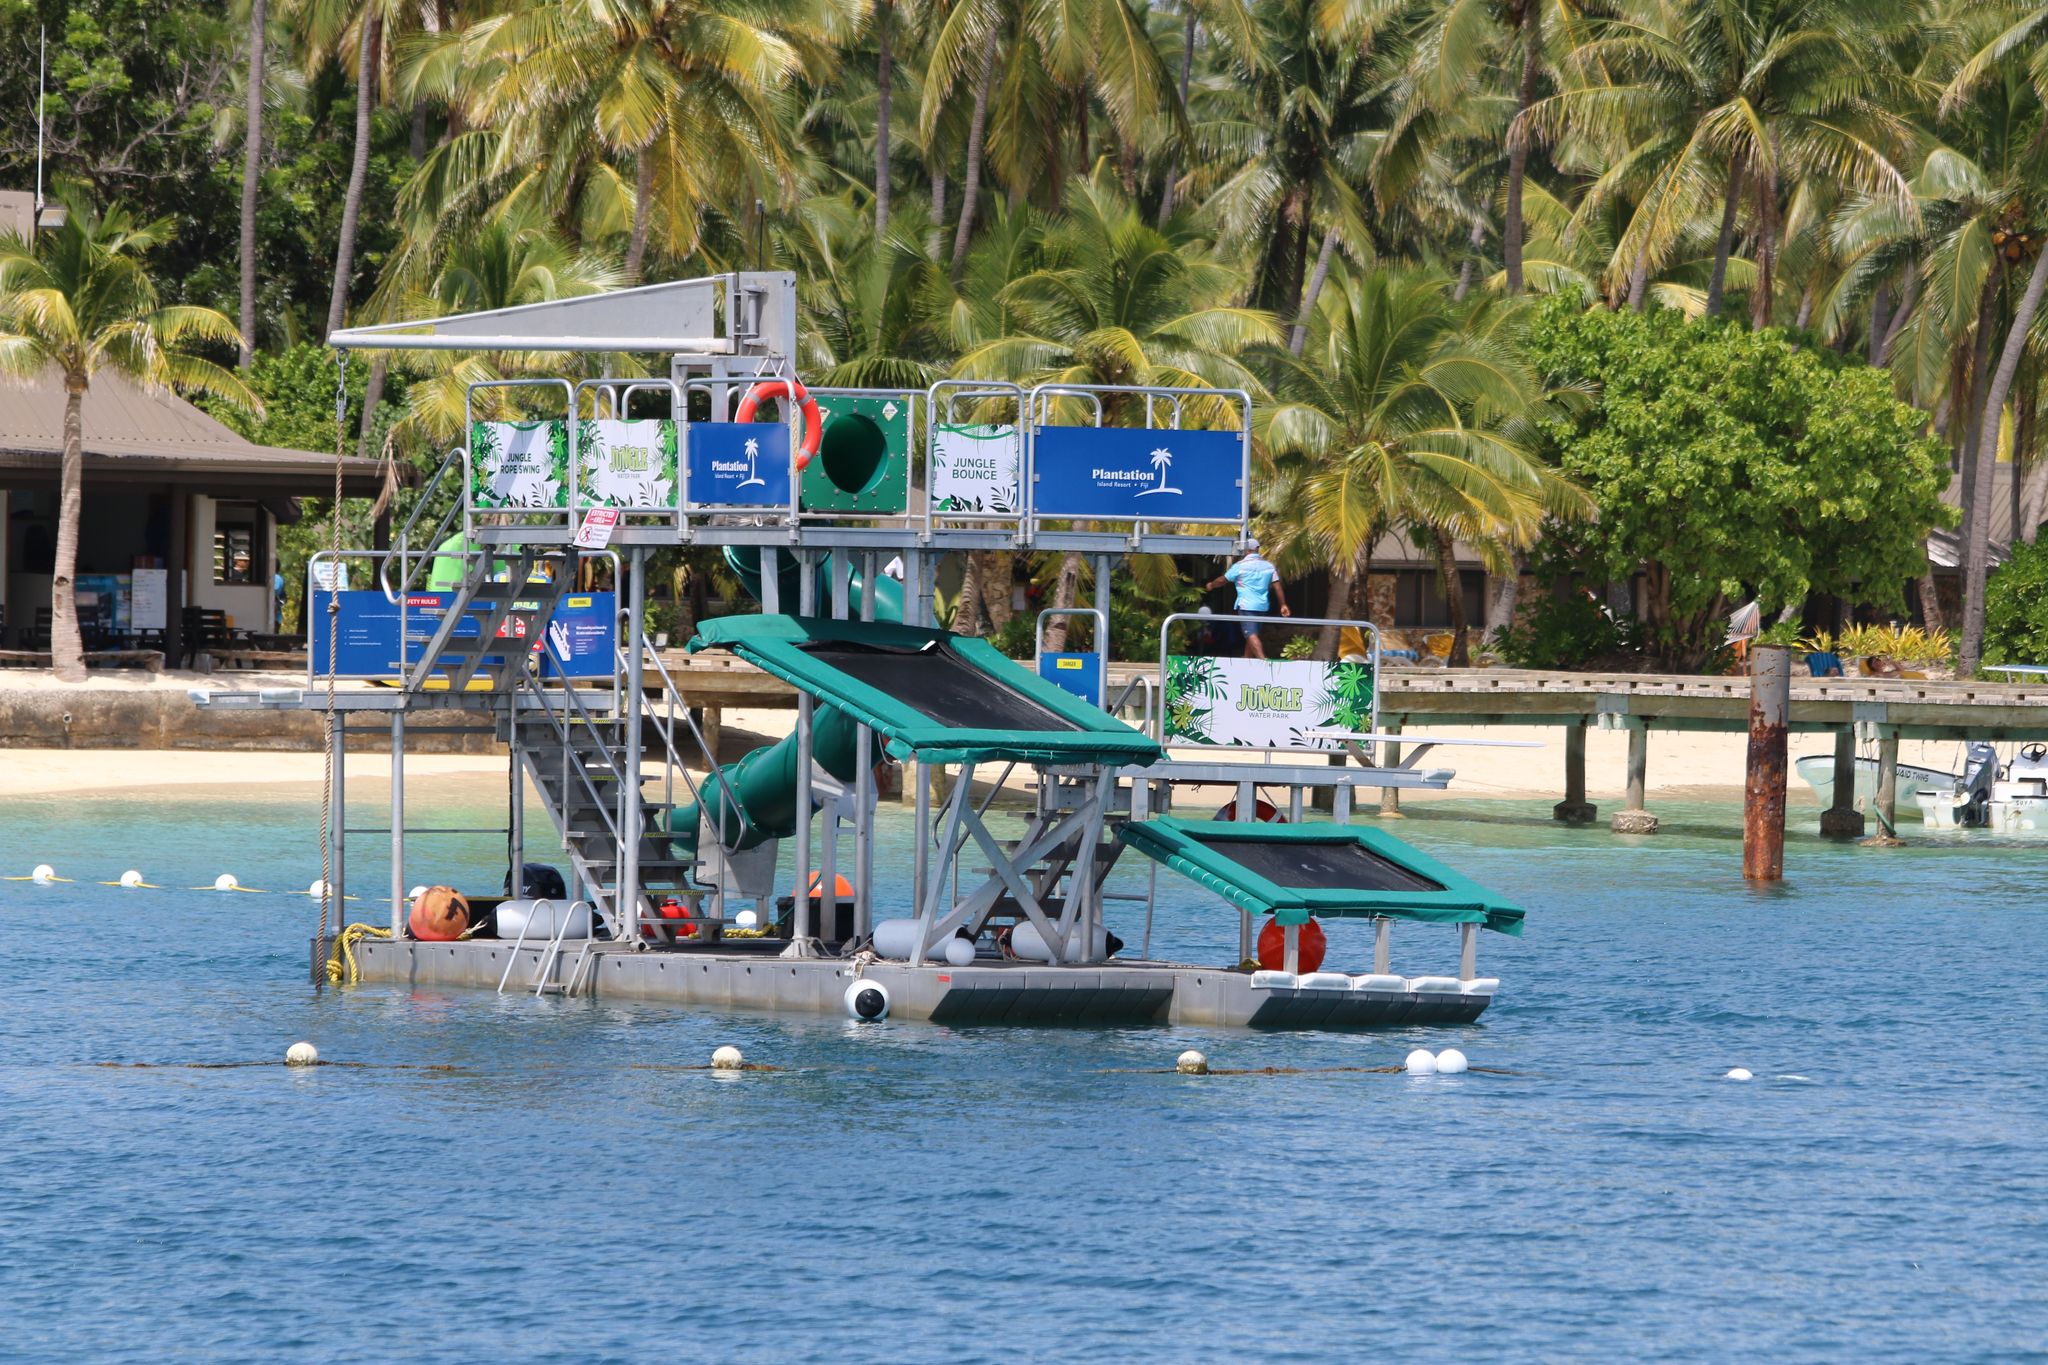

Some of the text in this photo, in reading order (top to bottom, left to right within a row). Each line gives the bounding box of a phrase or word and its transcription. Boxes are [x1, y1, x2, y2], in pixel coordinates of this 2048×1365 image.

[507, 452, 532, 462] JUNGLE
[609, 444, 648, 472] JUNGLE
[953, 457, 997, 469] JUNGLE
[501, 464, 541, 474] ROPE SWING
[711, 460, 749, 472] Plantation
[952, 469, 998, 481] BOUNCE
[1092, 468, 1155, 481] Plantation
[1140, 482, 1149, 490] Fiji
[590, 509, 615, 519] ESTRICTED
[1236, 683, 1303, 712] JUNGLE
[1912, 771, 1929, 783] TWINS
